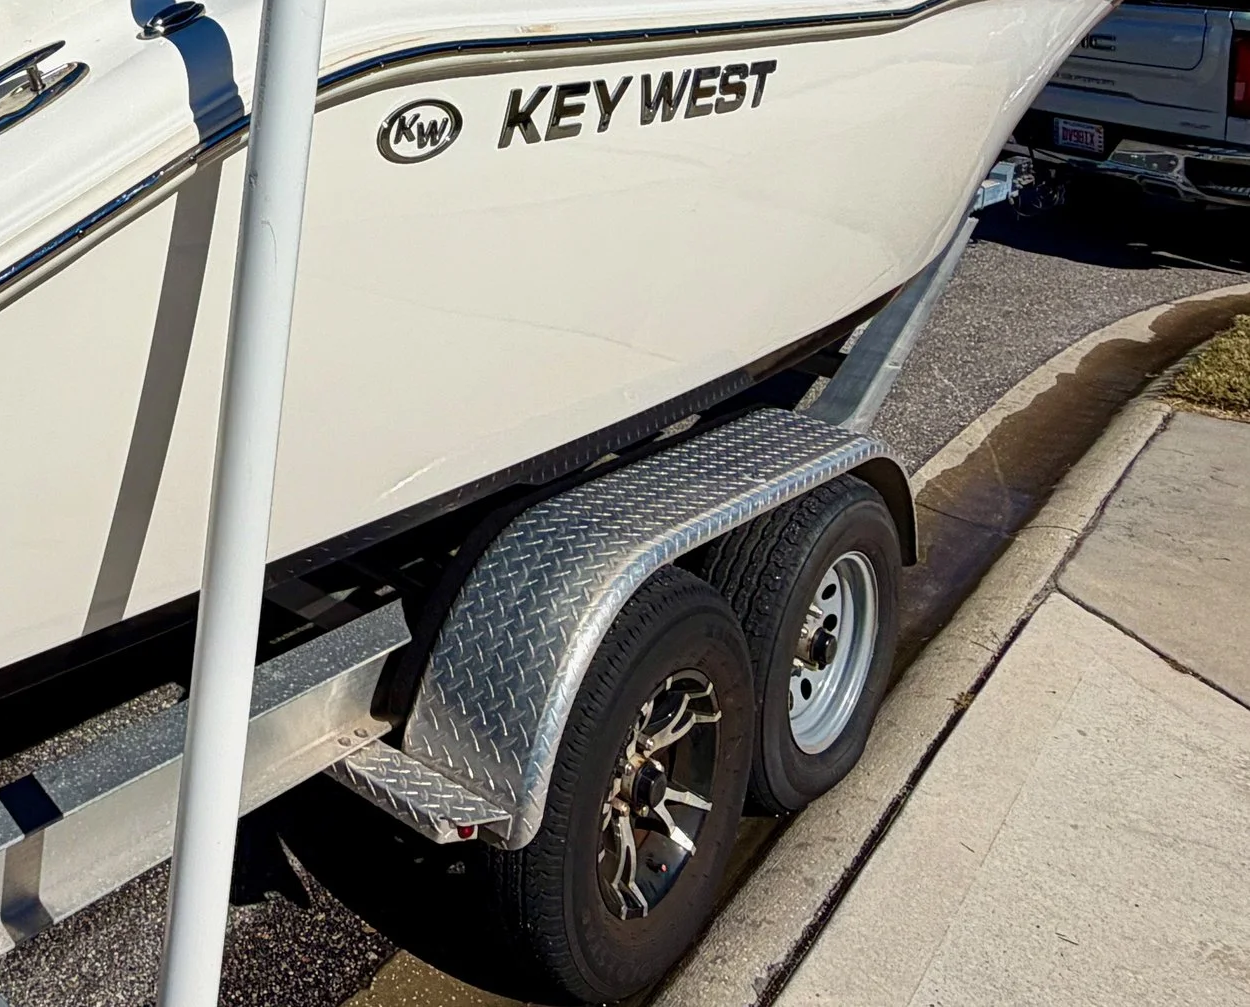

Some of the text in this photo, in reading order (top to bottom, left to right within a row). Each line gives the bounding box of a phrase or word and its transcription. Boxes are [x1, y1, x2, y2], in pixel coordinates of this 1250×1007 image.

[393, 112, 450, 150] KW
[497, 59, 778, 149] KEY WEST
